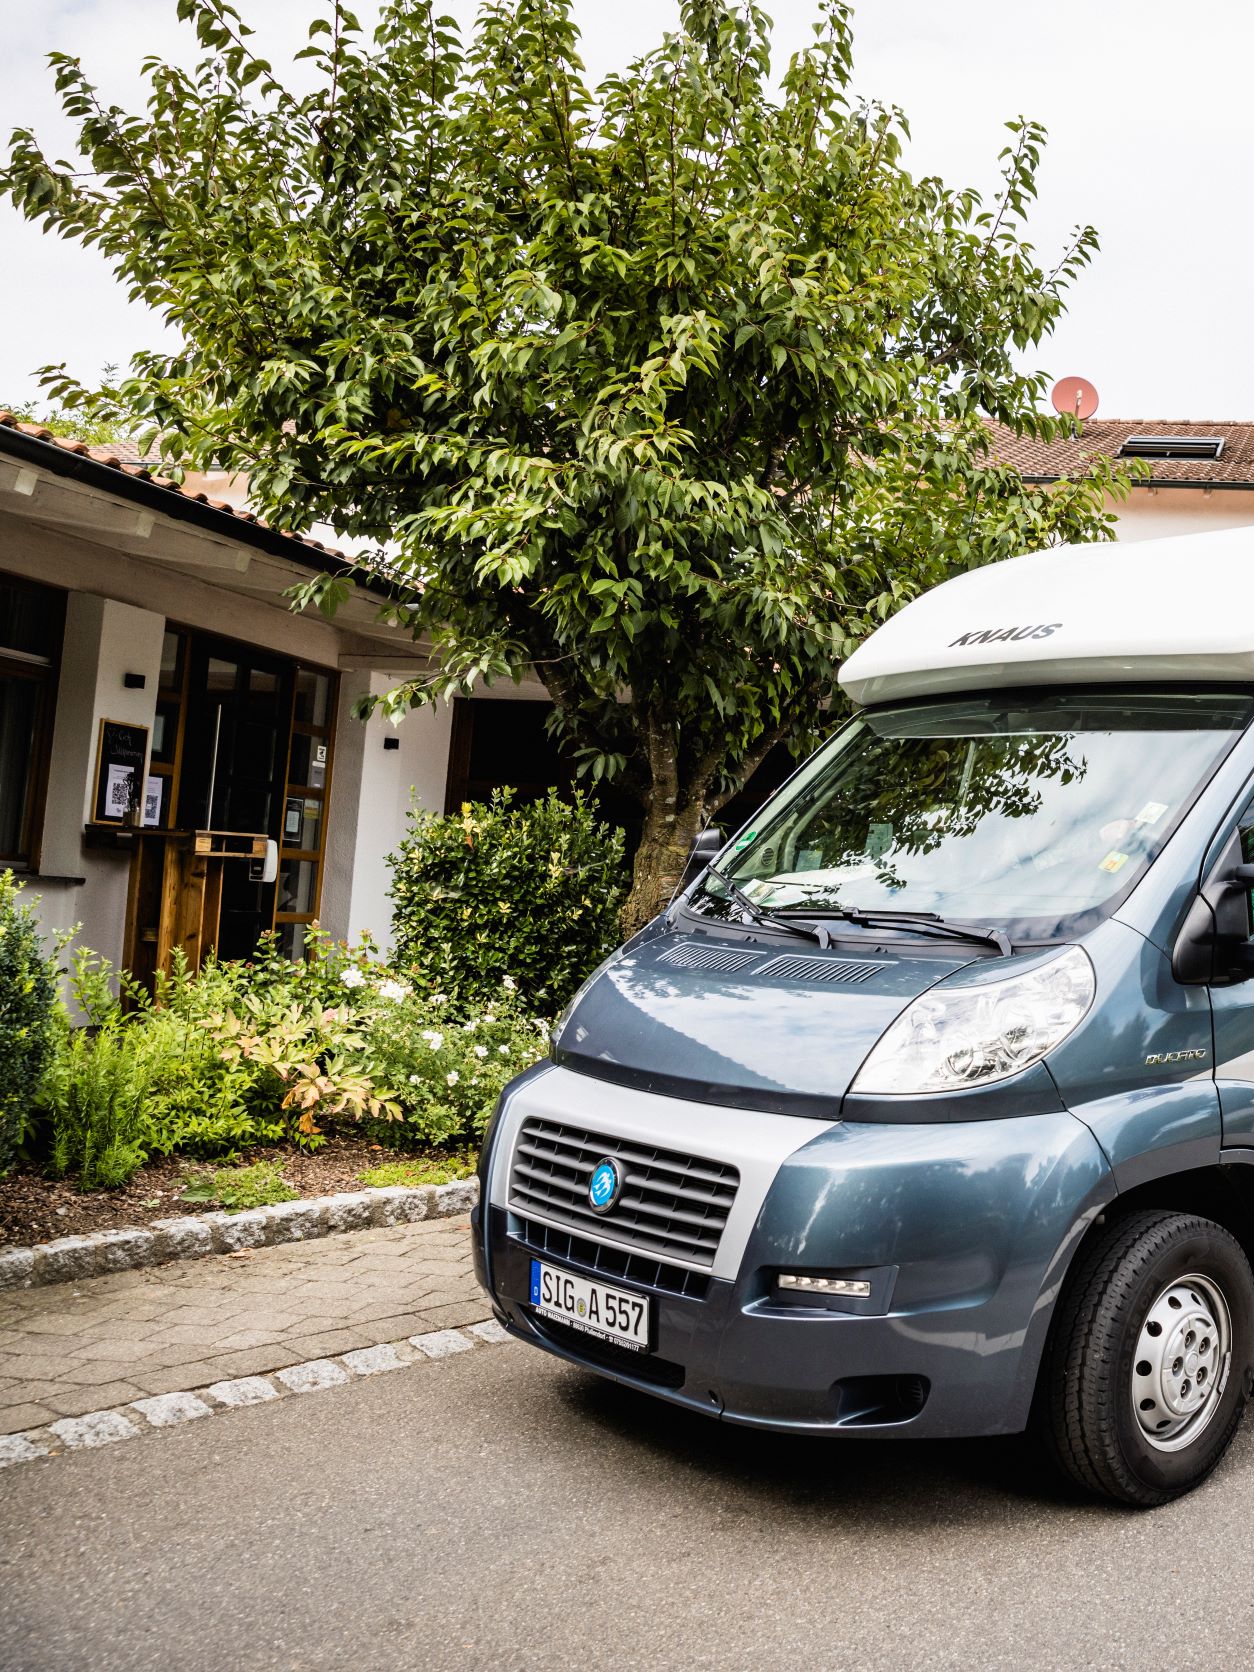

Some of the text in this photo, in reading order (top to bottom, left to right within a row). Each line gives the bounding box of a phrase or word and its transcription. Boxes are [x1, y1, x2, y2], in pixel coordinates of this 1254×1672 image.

[947, 623, 1063, 647] KNAUS
[1145, 1049, 1206, 1065] DUCATO
[542, 1271, 644, 1336] SIG A 557
